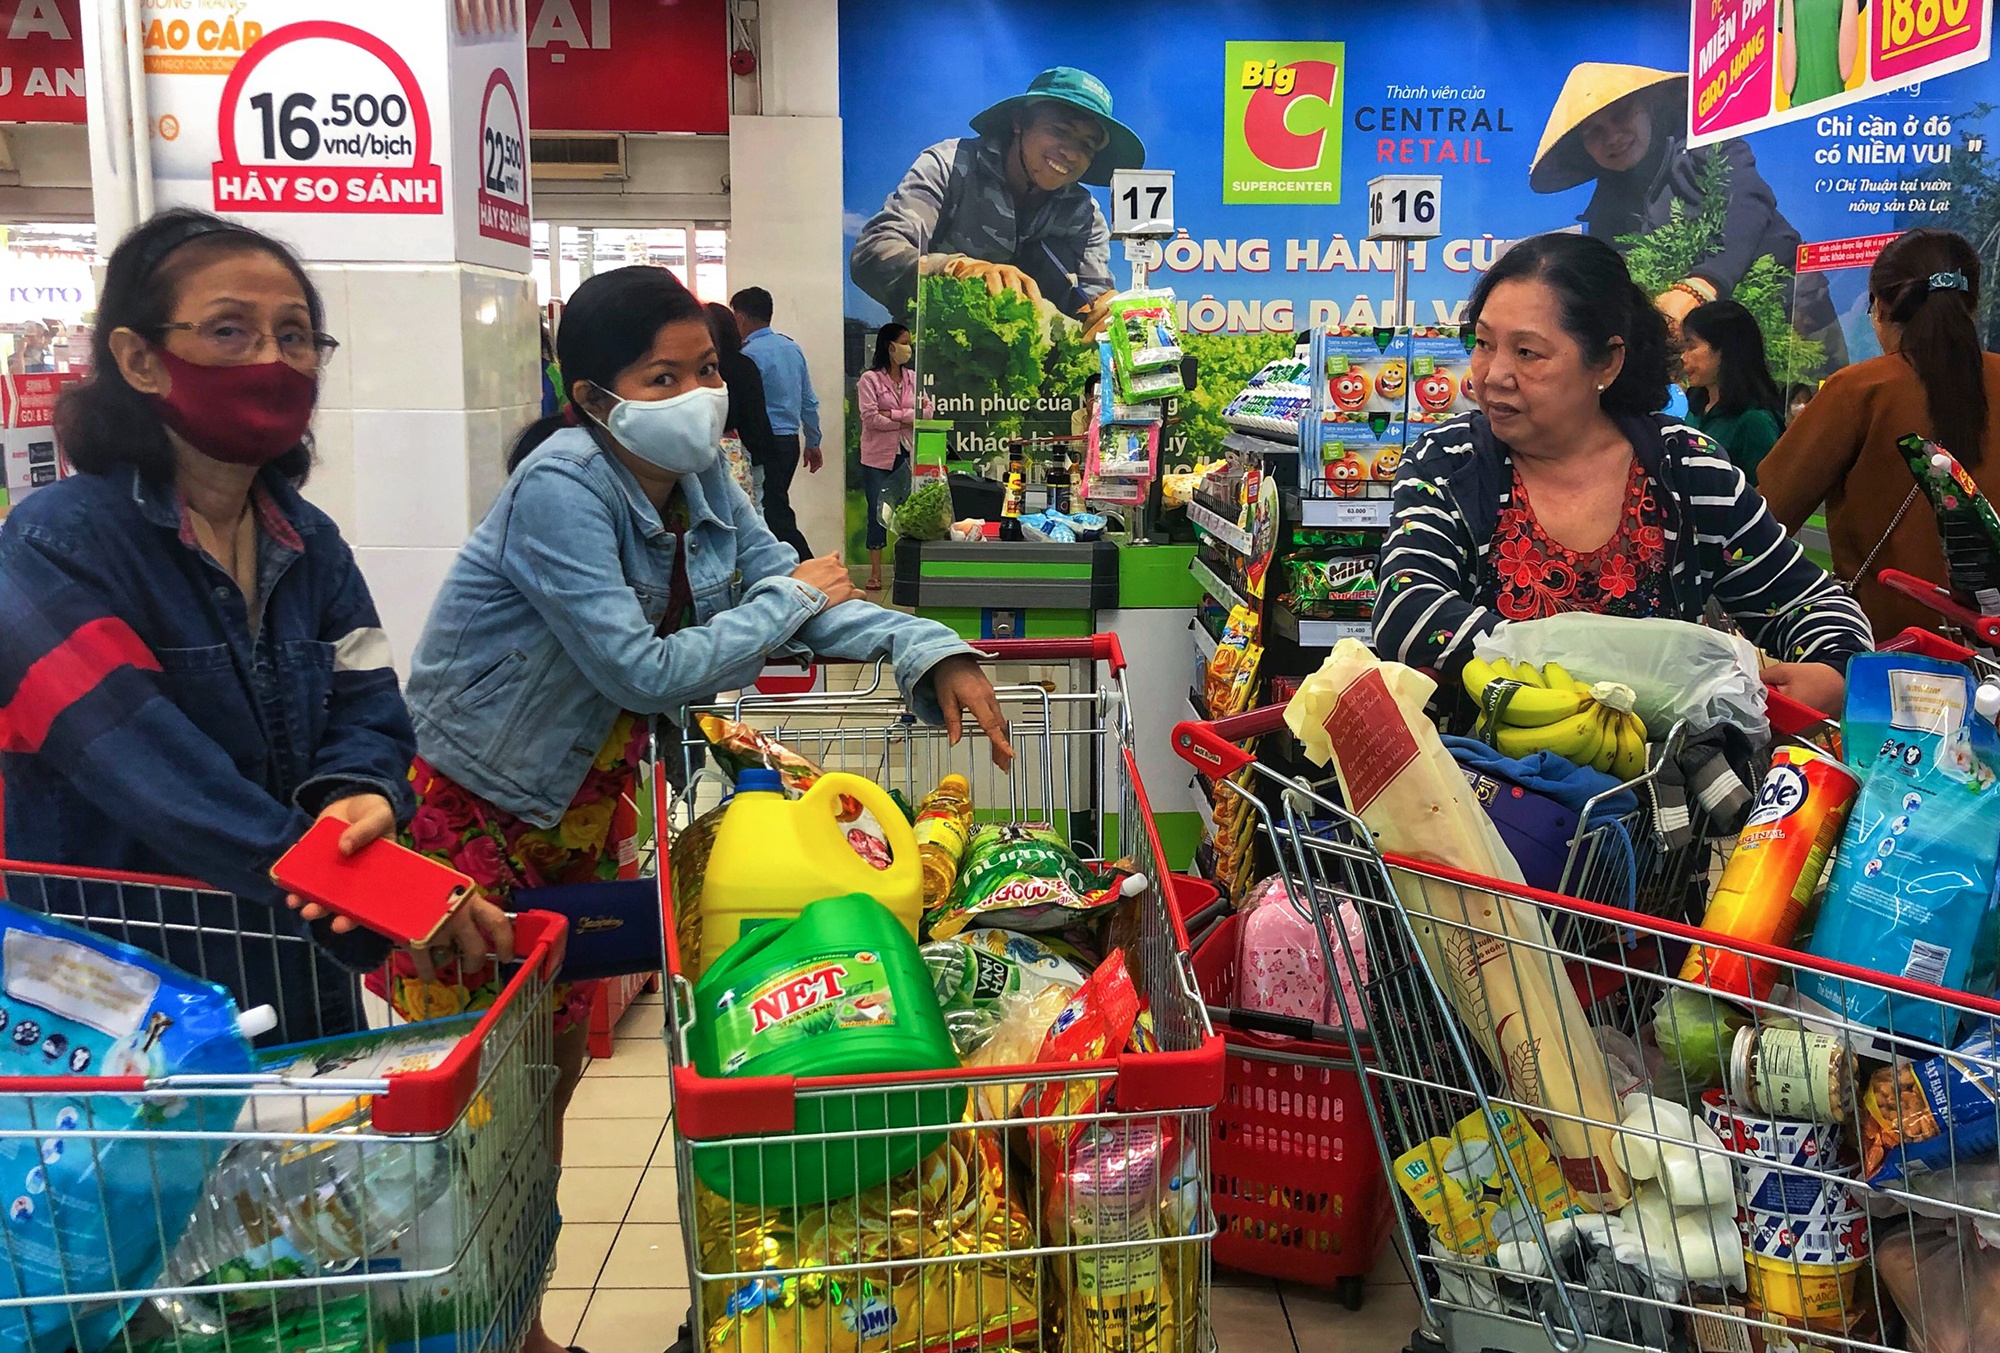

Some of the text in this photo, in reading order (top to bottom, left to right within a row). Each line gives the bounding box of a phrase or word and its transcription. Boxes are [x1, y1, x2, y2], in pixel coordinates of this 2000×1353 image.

[141, 19, 190, 50] AO
[1698, 25, 1766, 118] GIAO HÀNG
[1386, 84, 1487, 101] Thành viên của
[1240, 58, 1338, 172] Big C
[1353, 105, 1514, 134] CENTRAL
[1816, 114, 1952, 137] Chỉ cần ở đó
[323, 134, 413, 160] vnd/bịch
[1376, 137, 1492, 165] RETAIL
[1814, 143, 1842, 165] có
[1847, 138, 1906, 164] NIỀM
[1912, 144, 1951, 164] VUI
[218, 172, 438, 204] HÃY SO SÁNH
[1231, 180, 1334, 193] SUPERCENTER
[1835, 178, 1857, 195] Chị
[1859, 178, 1898, 195] Thuận
[1900, 179, 1918, 195] tại
[1920, 178, 1952, 192] vườn
[1121, 186, 1168, 220] 17
[1370, 191, 1383, 226] 16
[1391, 189, 1435, 223] 16
[1848, 198, 1951, 214] nông sản Đà Lạt
[1286, 233, 1427, 274] HÀNH
[1036, 390, 1073, 412] của
[748, 965, 848, 1034] NET
[854, 1305, 899, 1333] OMO
